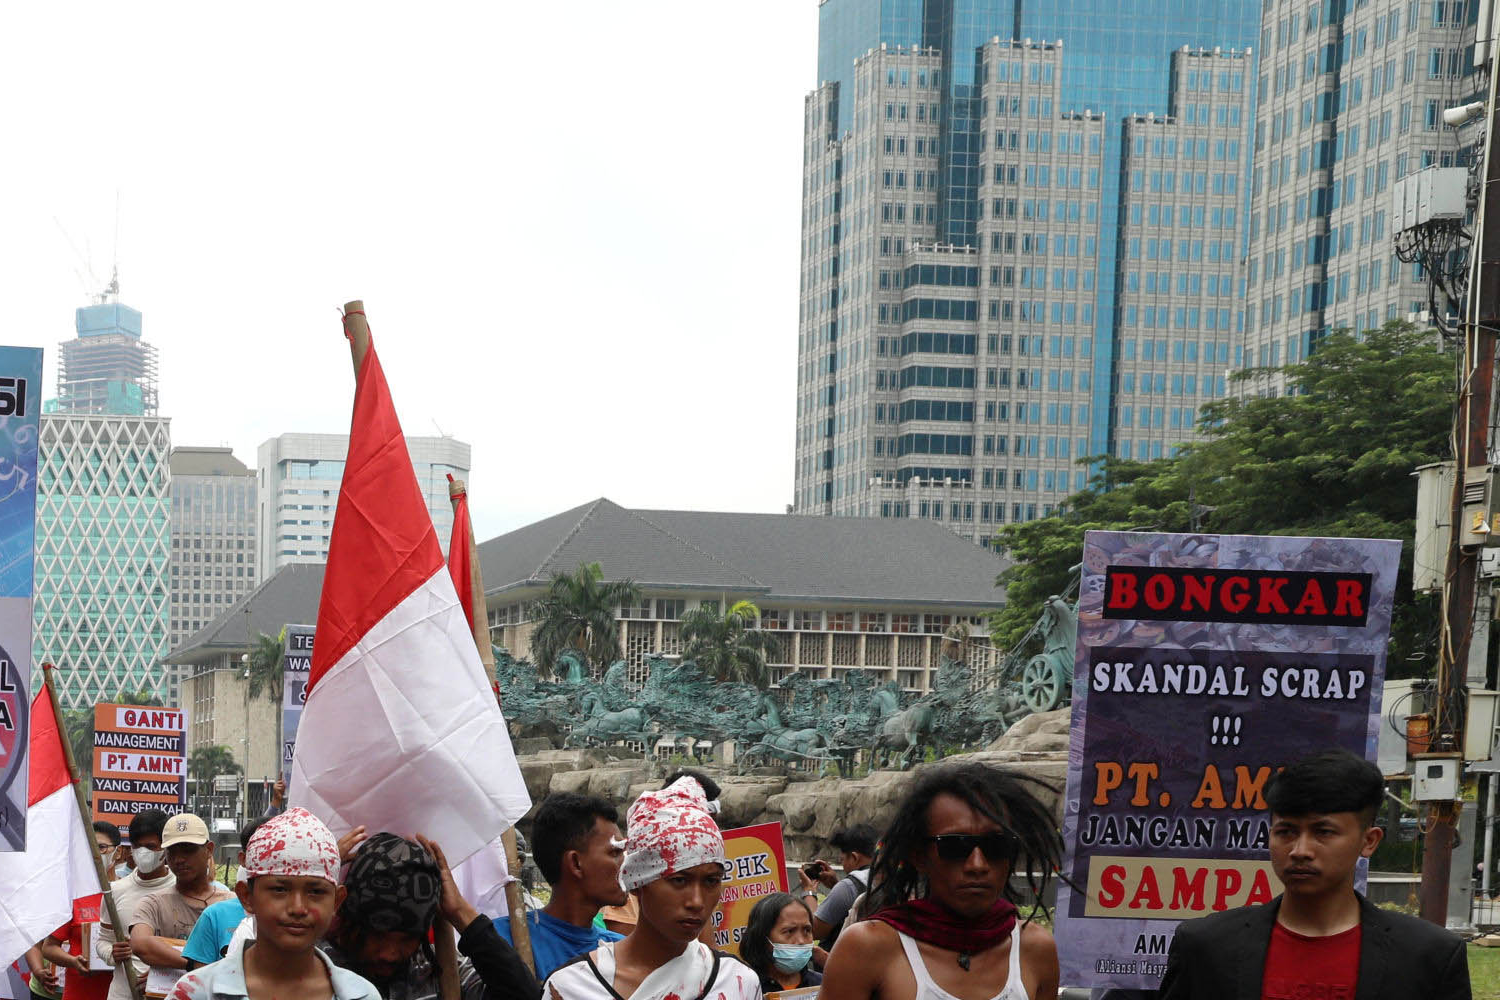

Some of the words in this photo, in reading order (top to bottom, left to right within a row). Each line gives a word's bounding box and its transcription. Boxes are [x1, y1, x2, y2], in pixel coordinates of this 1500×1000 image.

[1107, 572, 1364, 617] BONGKAR
[1093, 662, 1249, 697] SKANDAL
[1260, 667, 1365, 699] SCRAP
[125, 710, 183, 729] GANTI
[1210, 715, 1243, 746] !!!
[94, 732, 179, 750] MANAGEMENT
[108, 754, 131, 770] PT.
[137, 756, 183, 773] AMNT
[96, 779, 130, 791] YANG
[134, 781, 179, 794] TAMAK
[1093, 762, 1171, 808] PT.
[1191, 764, 1285, 810] AM
[104, 801, 128, 812] DAN
[1081, 815, 1216, 848] JANGAN
[742, 881, 777, 898] KERJA
[1099, 865, 1273, 912] SAMPA
[1096, 960, 1137, 974] (Aliansi
